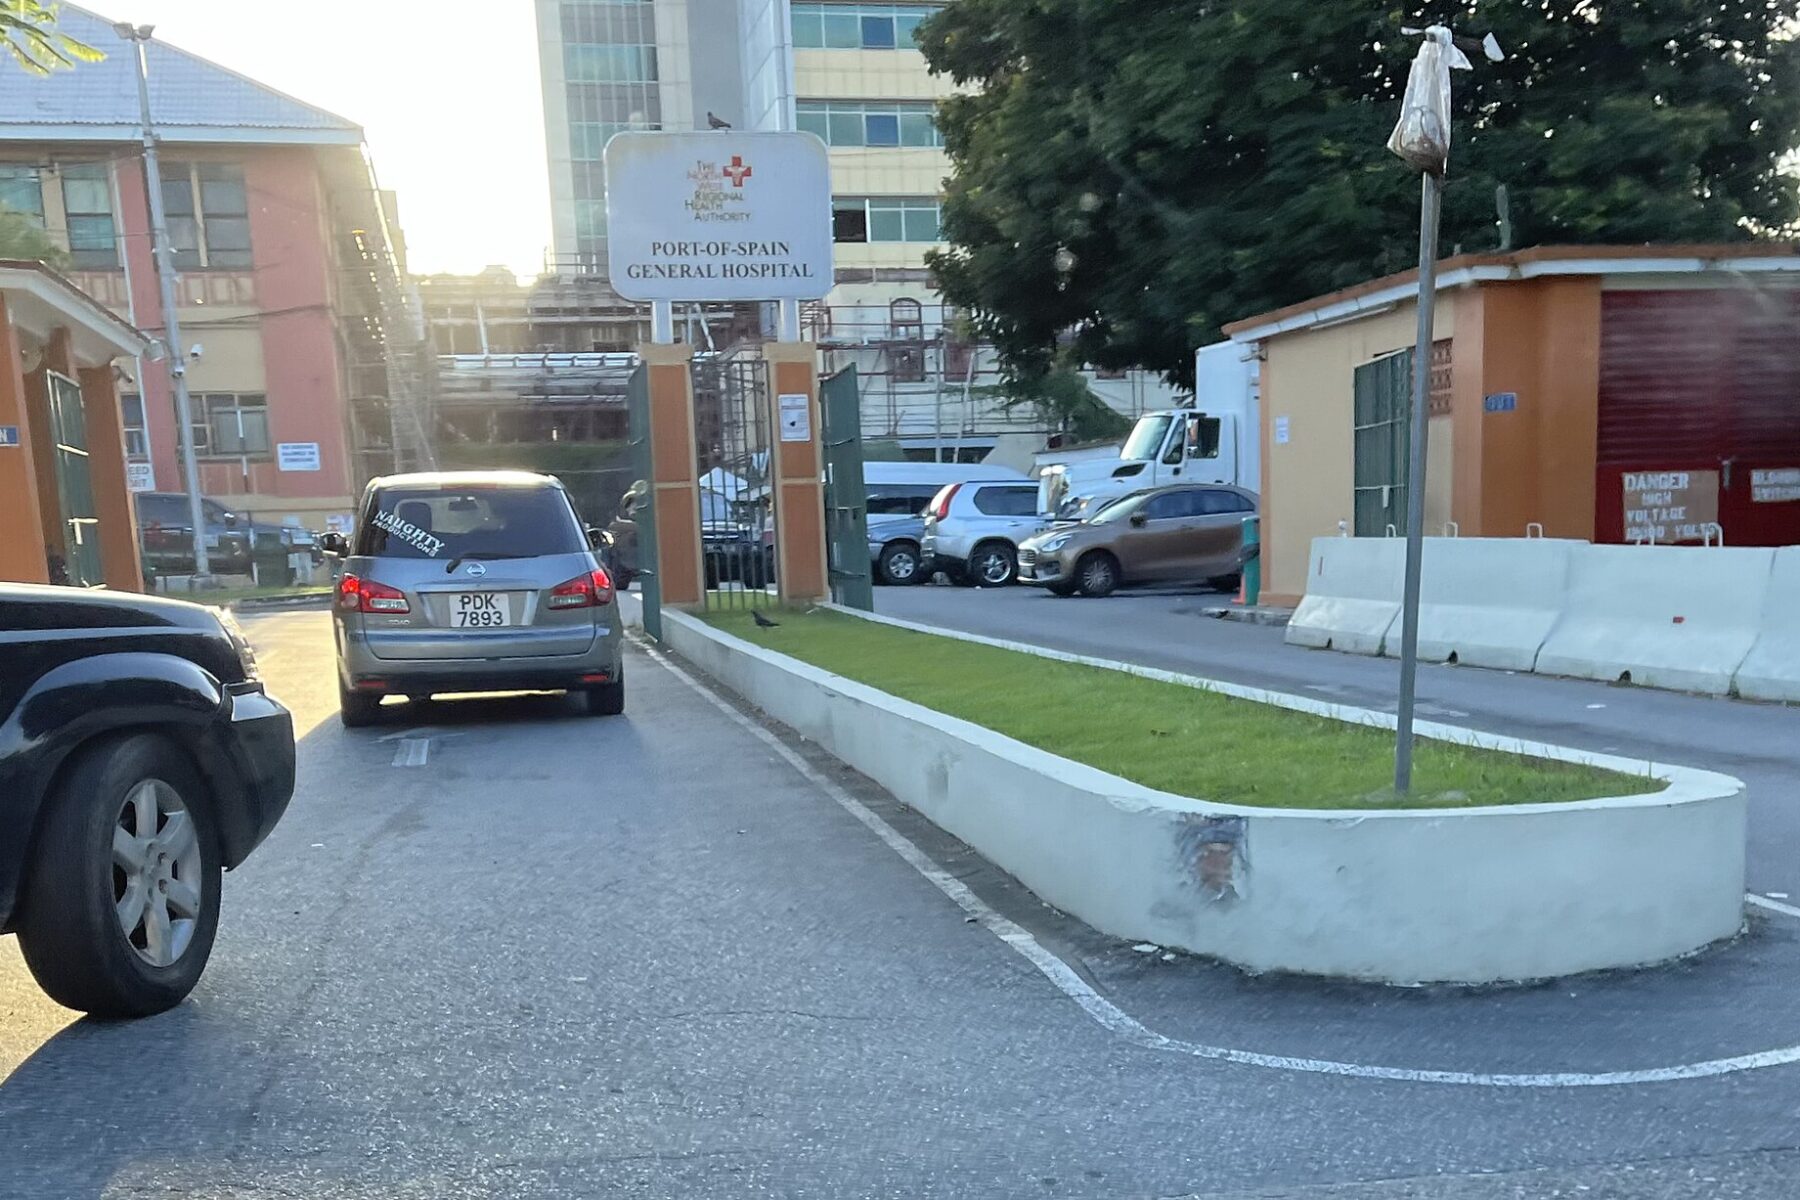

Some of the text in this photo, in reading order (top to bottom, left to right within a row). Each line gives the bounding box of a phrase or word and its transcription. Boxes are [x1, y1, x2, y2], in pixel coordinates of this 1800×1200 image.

[694, 190, 744, 201] REGIONAL
[684, 199, 724, 210] HEALTH
[694, 211, 751, 222] AUTHORITY
[651, 241, 790, 256] PORT-OF-SPAIN
[627, 263, 814, 279] GENERAL HOSPITAL
[1624, 473, 1689, 490] DANGER
[1627, 507, 1686, 522] VOLTAGE
[371, 519, 437, 558] PRODUCTIONS
[374, 510, 445, 552] NAUGHTY
[460, 594, 496, 610] PDK
[457, 611, 503, 627] 7893
